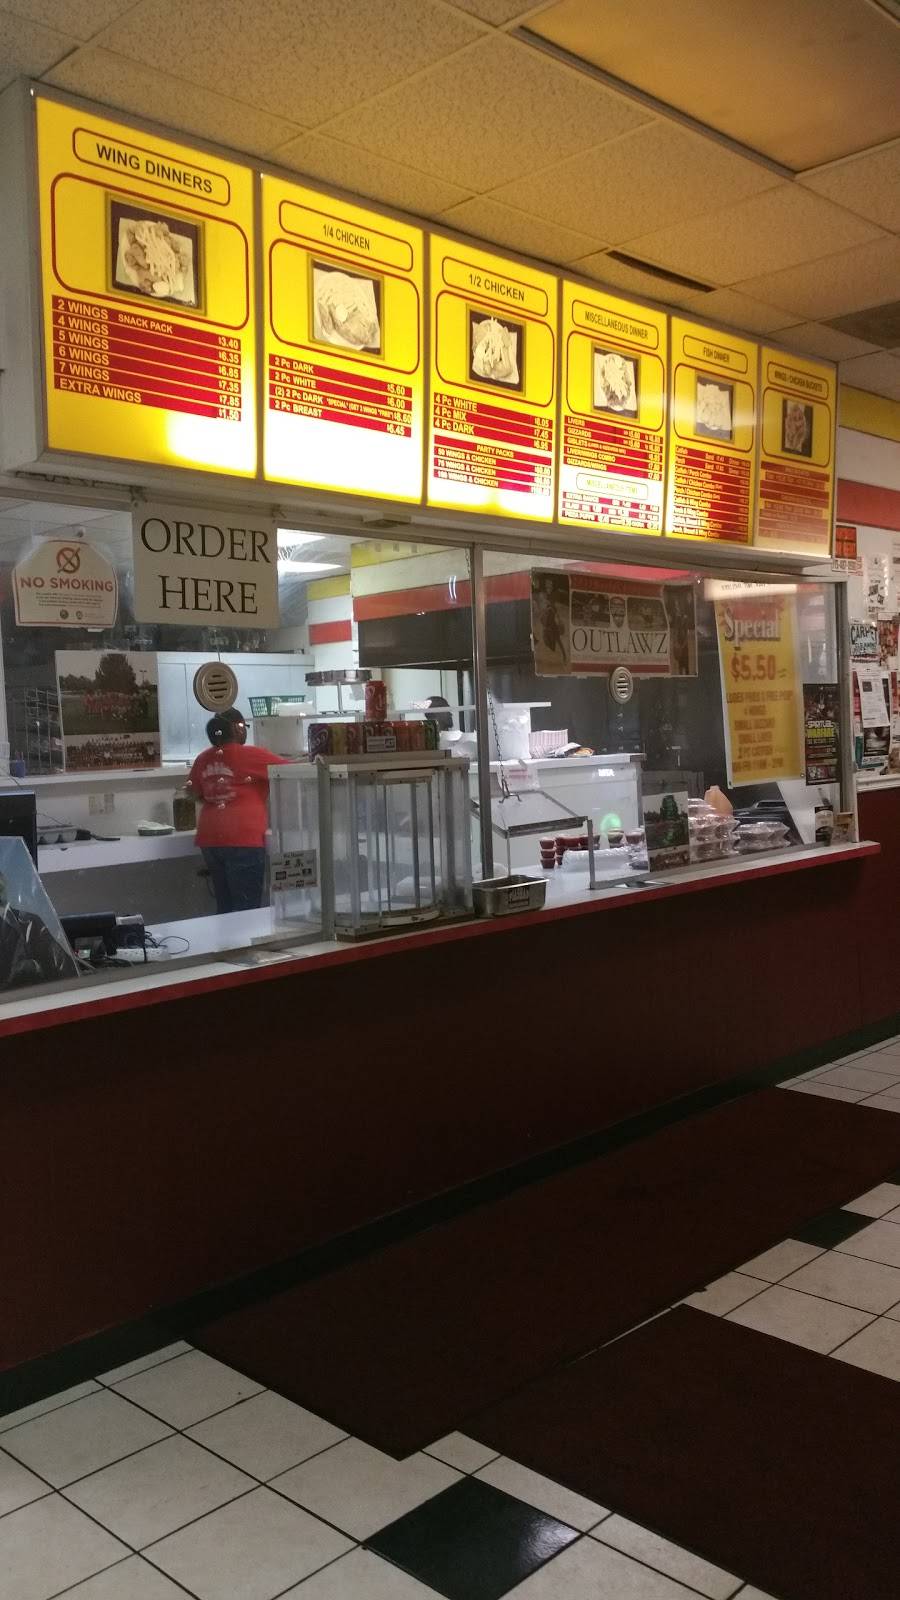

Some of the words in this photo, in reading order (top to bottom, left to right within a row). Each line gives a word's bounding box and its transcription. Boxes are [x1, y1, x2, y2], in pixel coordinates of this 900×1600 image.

[96, 143, 140, 171] WING
[145, 158, 213, 194] DINNERS
[323, 224, 333, 240] 1/4
[335, 228, 370, 251] CHICKEN
[469, 274, 482, 288] 1/2
[484, 280, 525, 302] CHICKEN
[58, 299, 65, 310] 2
[68, 301, 109, 320] WINGS
[118, 313, 149, 329] SNACK
[150, 319, 173, 335] PACK
[58, 315, 65, 326] 4
[68, 316, 109, 336] WINGS
[585, 311, 629, 333] MISCELLANEOUS
[630, 325, 649, 340] DINNER
[59, 330, 66, 341] 5
[69, 331, 109, 350] WINGS
[59, 346, 66, 357] 6
[69, 347, 109, 366] WINGS
[274, 356, 280, 366] 2
[292, 360, 314, 374] DARK
[59, 362, 66, 373] 7
[69, 363, 110, 382] WINGS
[274, 371, 280, 381] 2
[293, 376, 316, 389] WHITE
[60, 378, 100, 396] EXTRA
[102, 386, 142, 403] WINGS
[286, 388, 291, 398] 2
[302, 391, 324, 405] DARK
[274, 399, 280, 409] 2
[292, 403, 323, 418] BREAST
[435, 394, 440, 403] 4
[453, 397, 478, 412] WHITE
[435, 406, 440, 415] 4
[453, 409, 467, 421] MIX
[435, 418, 440, 428] 4
[453, 422, 475, 435] DARK
[471, 454, 496, 466] CHICKEN
[476, 444, 495, 456] PARTY
[471, 465, 496, 477] CHICKEN
[473, 477, 498, 488] CHICKEN
[140, 517, 272, 564] ORDER
[20, 577, 45, 588] NO
[50, 577, 114, 592] SMOKING
[158, 575, 259, 615] HERE
[724, 607, 781, 649] Special
[572, 628, 668, 655] OUTLAWZ
[730, 653, 776, 682] $5.50
